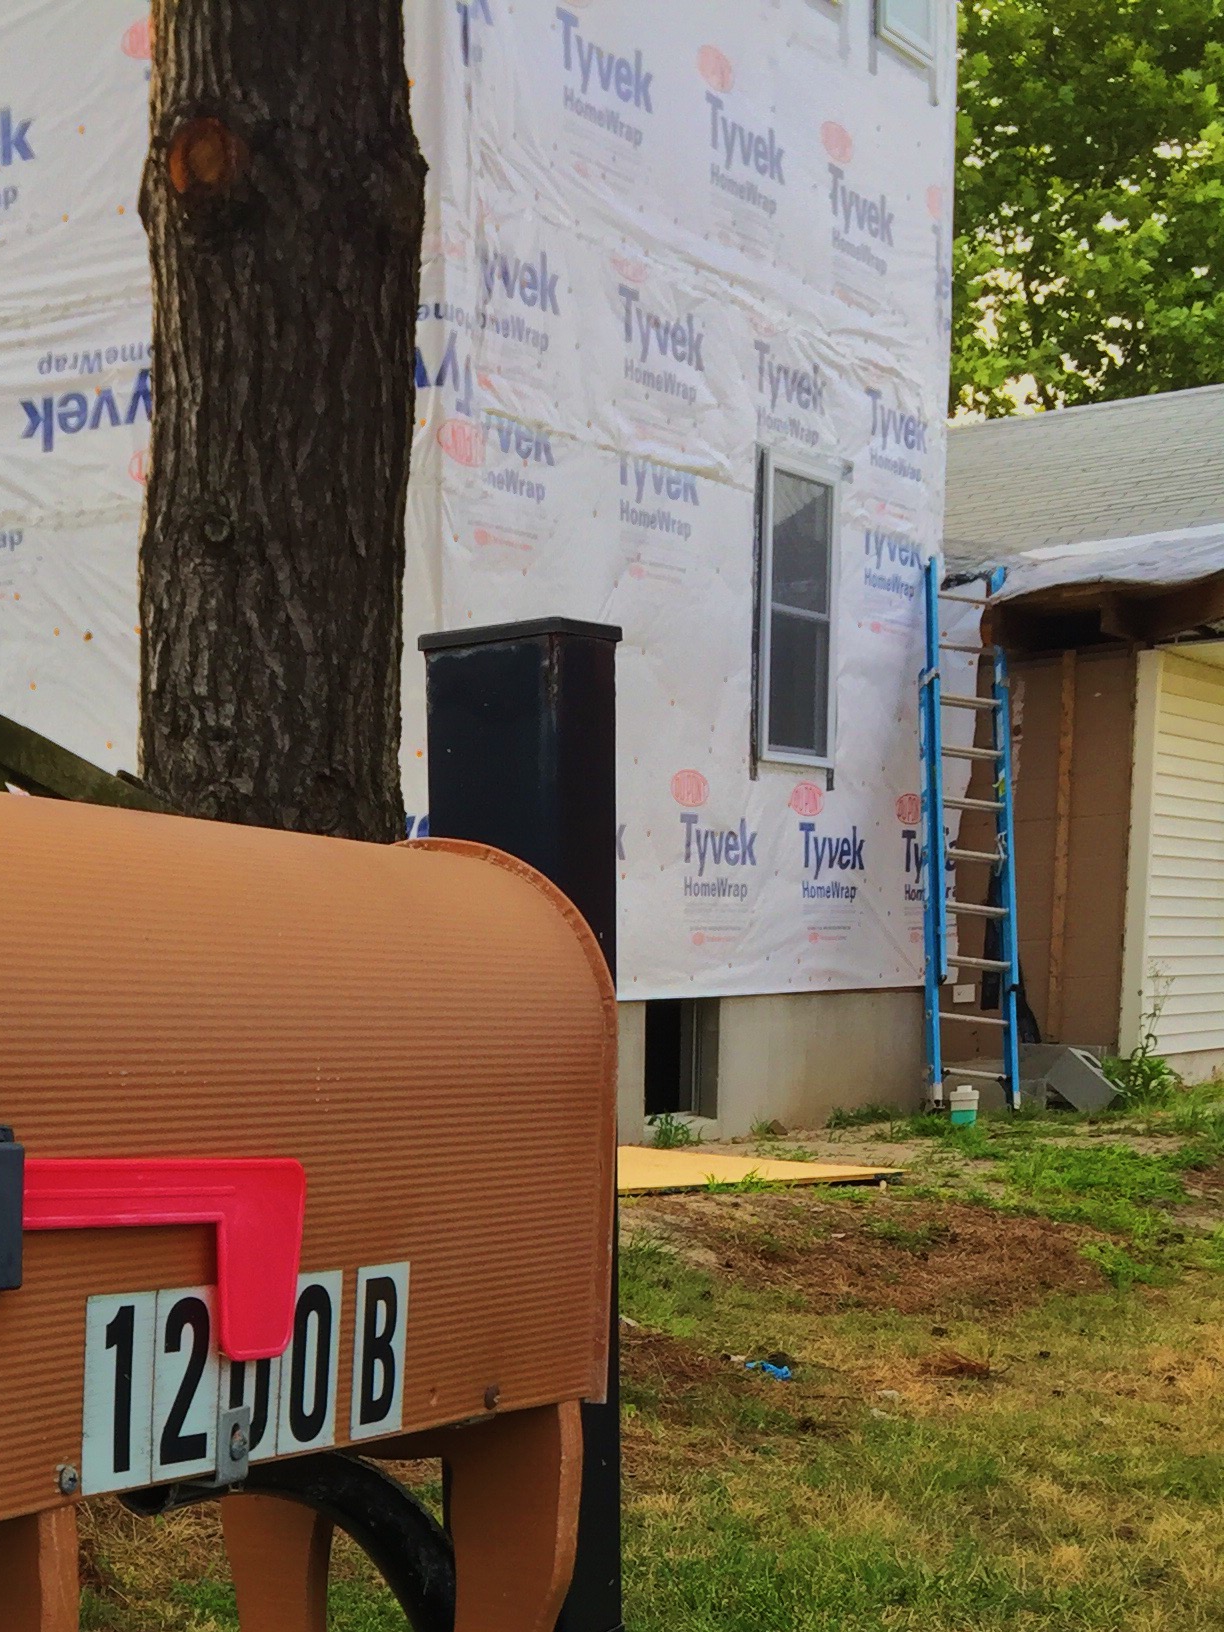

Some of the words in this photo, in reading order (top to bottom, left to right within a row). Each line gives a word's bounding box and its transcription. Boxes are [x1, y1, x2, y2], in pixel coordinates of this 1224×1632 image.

[556, 6, 653, 114] Tyvek
[563, 84, 643, 148] HomeWrap
[705, 90, 785, 186] Tyvek
[828, 162, 894, 247] Tyvek
[618, 283, 704, 372] Tyvek
[19, 368, 153, 453] yvek
[624, 357, 696, 405] HomeWrap
[754, 339, 826, 417] Tyvek
[864, 386, 928, 454] Tyvek
[619, 498, 691, 541] HomeWrap
[680, 812, 757, 878] Tyvek
[799, 822, 866, 880] Tyvek
[683, 876, 748, 903] HomeWrap
[802, 880, 858, 903] HomeWrap
